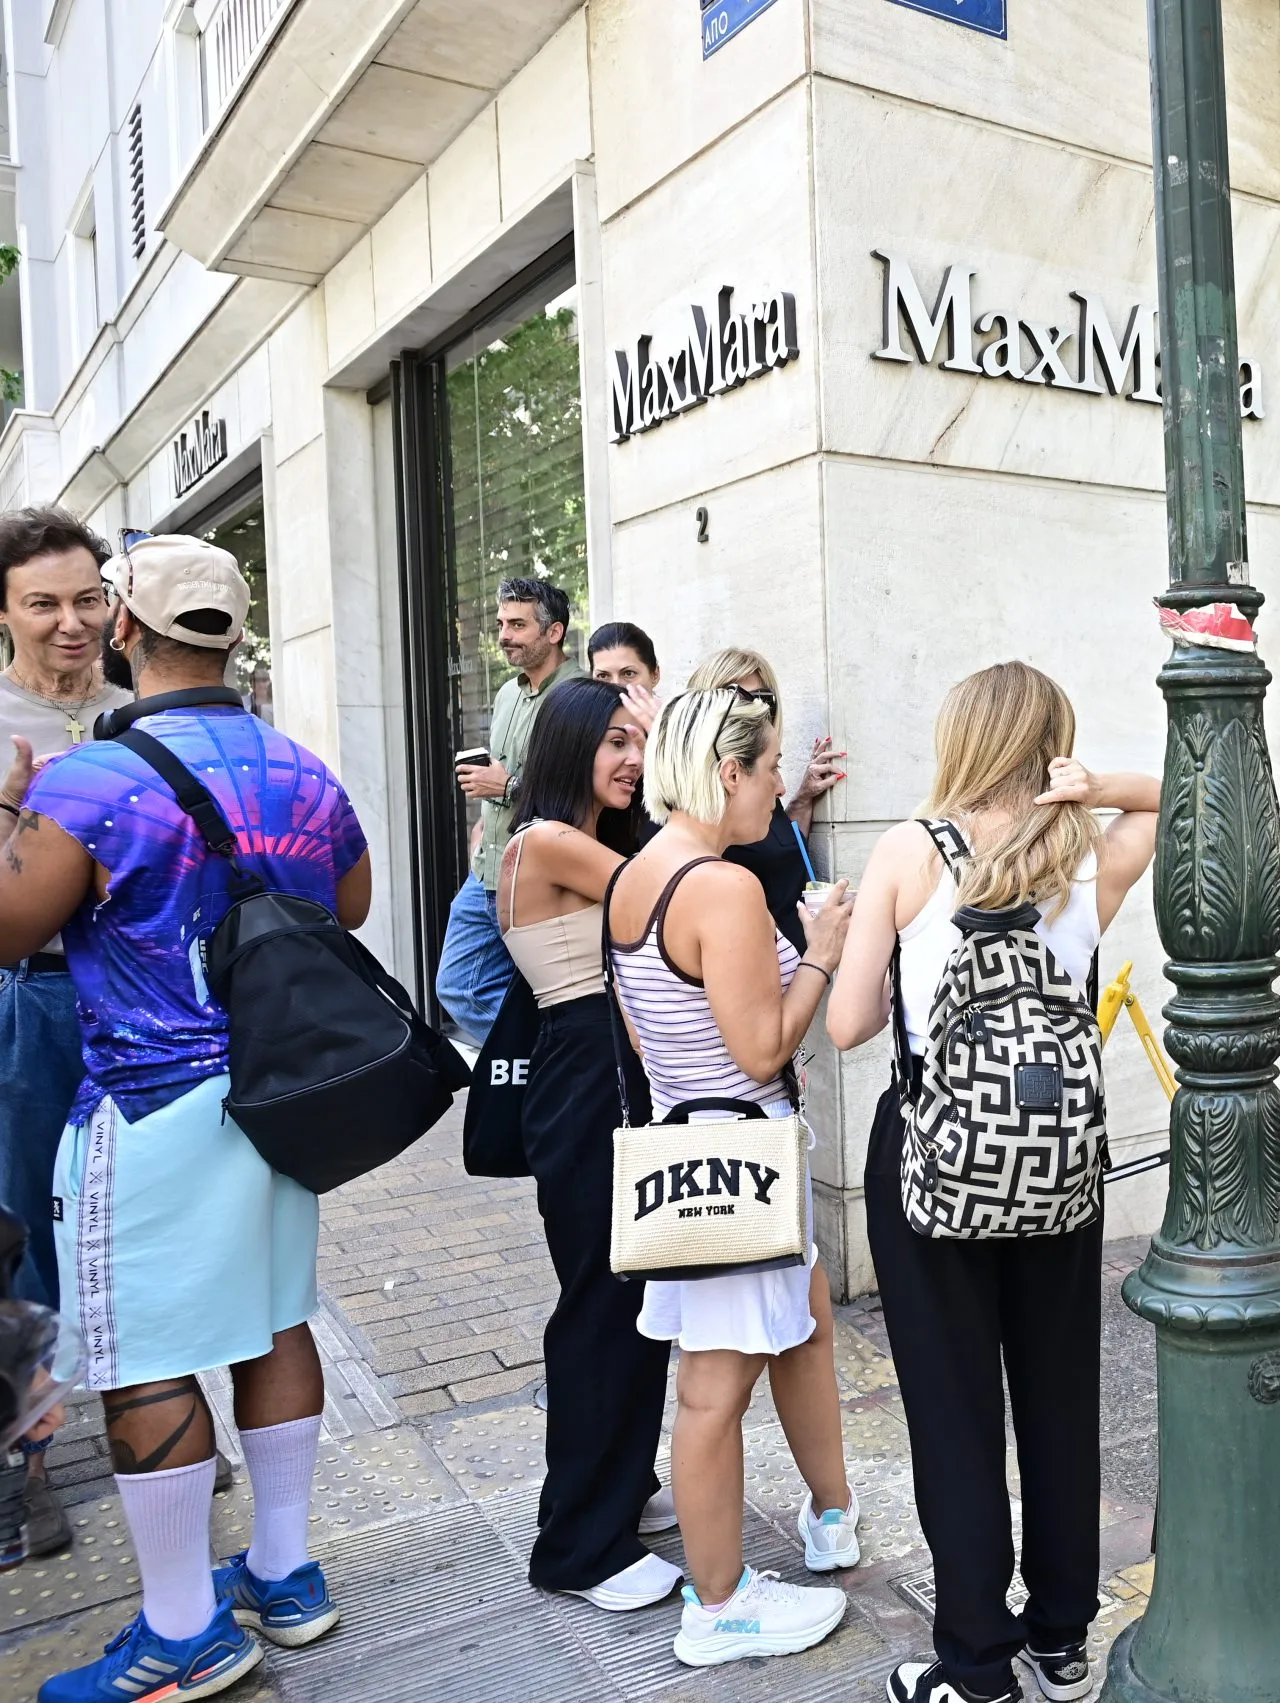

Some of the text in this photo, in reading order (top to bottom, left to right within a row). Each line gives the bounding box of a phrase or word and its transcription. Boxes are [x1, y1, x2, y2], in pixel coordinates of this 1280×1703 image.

[705, 11, 728, 49] ΑΠΟ
[870, 248, 1266, 420] MaxMa
[609, 285, 800, 445] MaxMara
[173, 410, 228, 499] MaxMara
[696, 506, 709, 543] 2
[92, 1121, 105, 1164] VINYL
[634, 1157, 780, 1221] DKNY
[88, 1191, 100, 1233] VINYL
[677, 1204, 735, 1219] NEW YORK
[88, 1258, 100, 1299] VINYL
[92, 1325, 105, 1365] VINYL
[713, 1618, 761, 1634] HOKA
